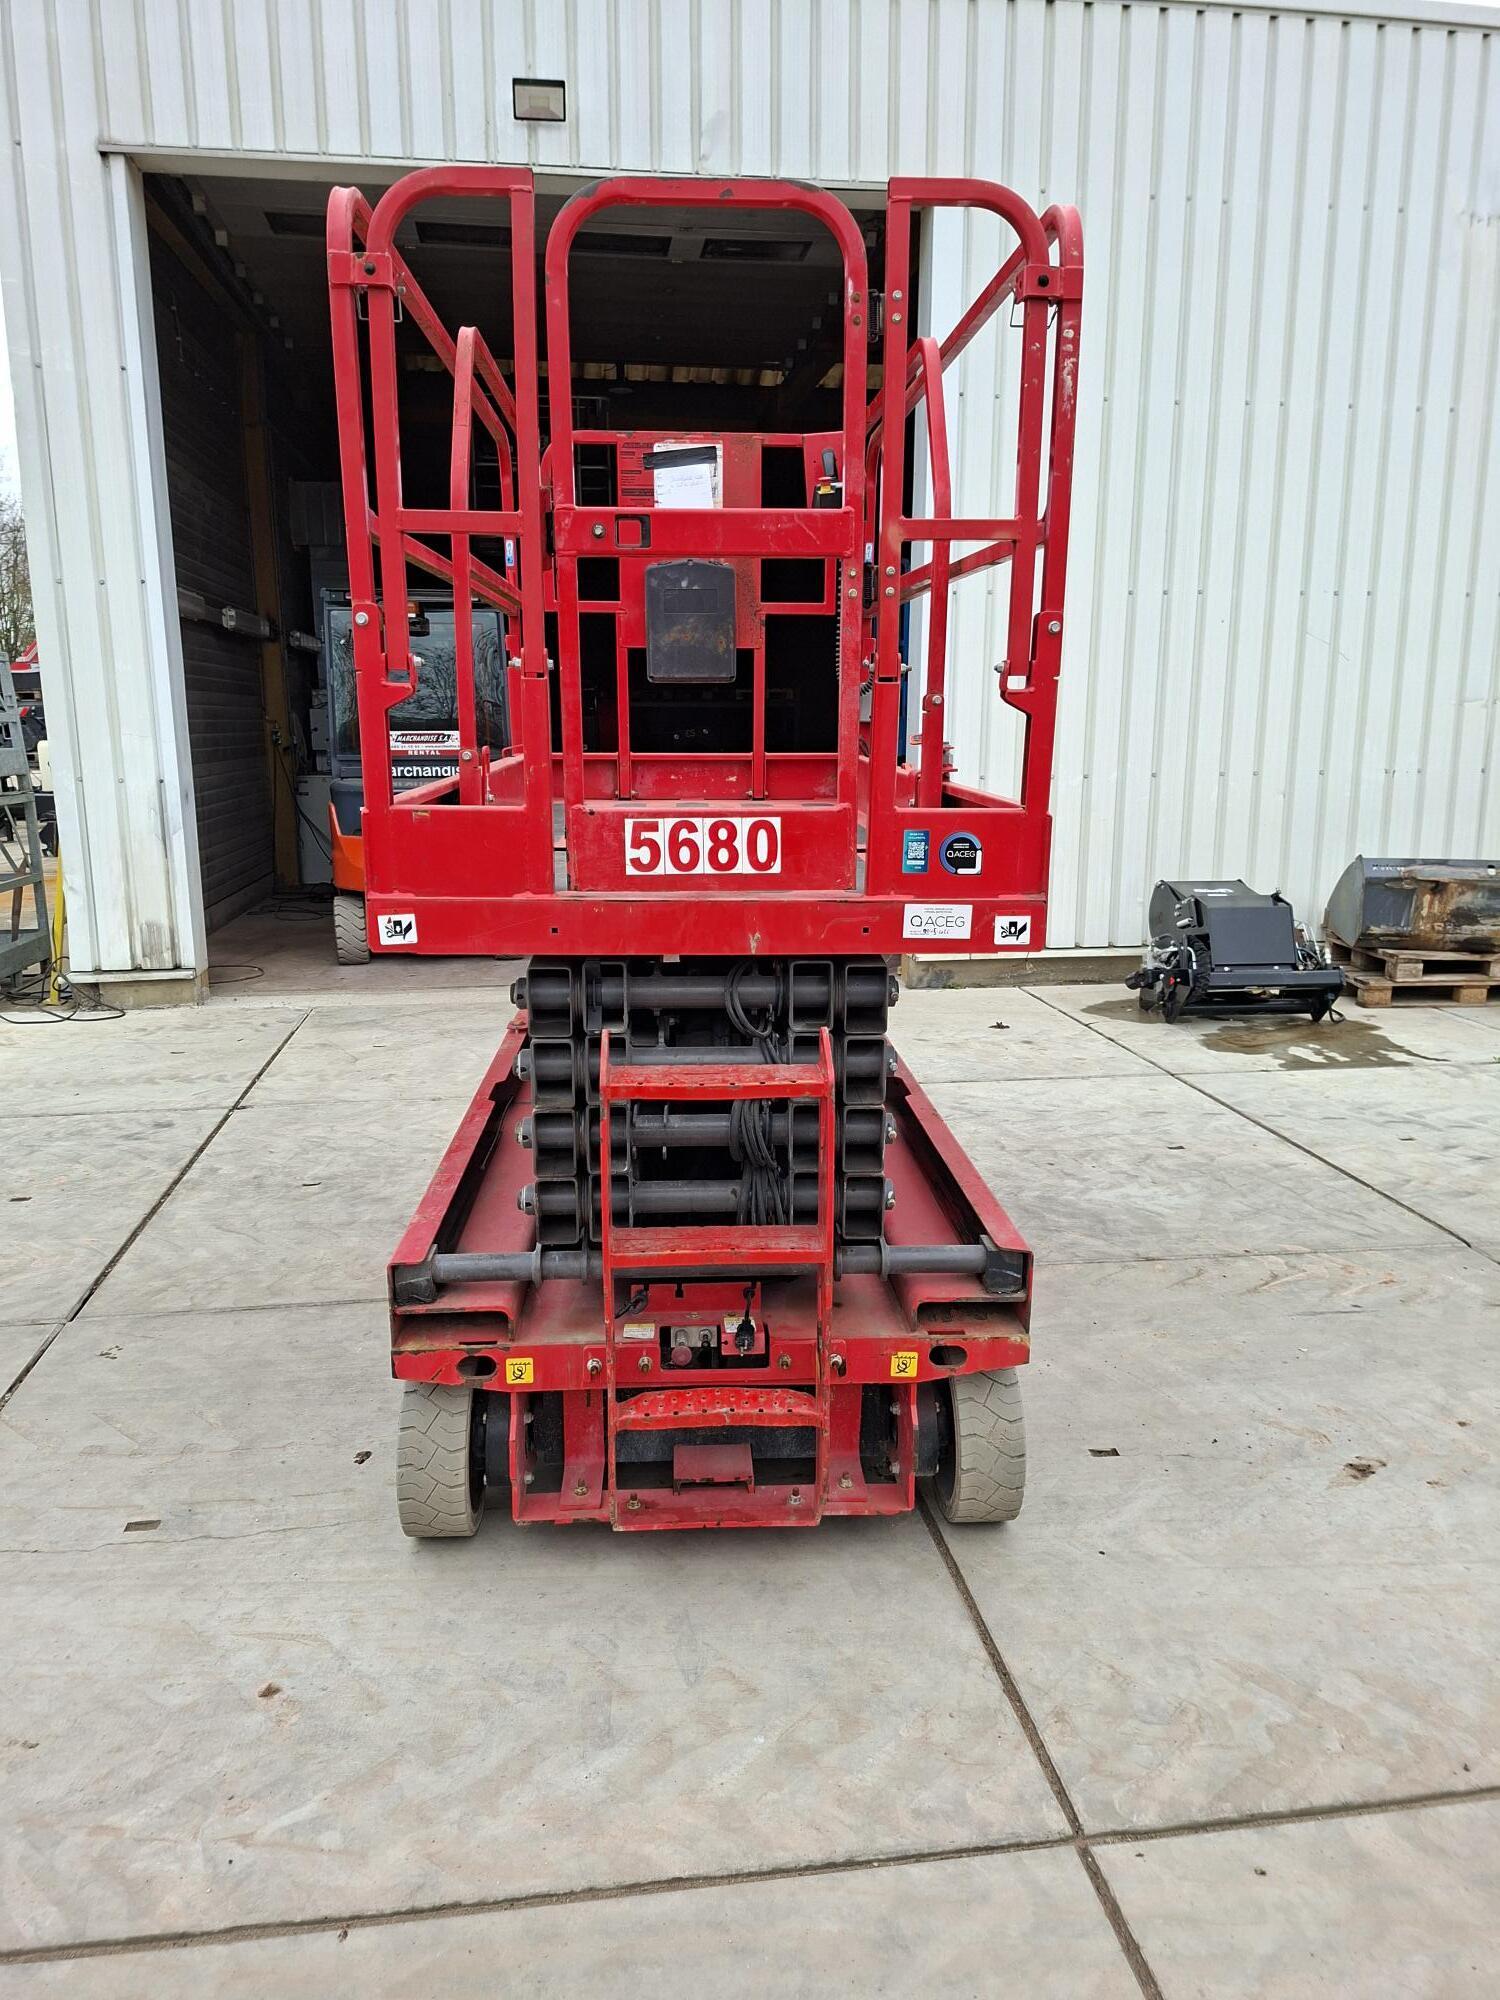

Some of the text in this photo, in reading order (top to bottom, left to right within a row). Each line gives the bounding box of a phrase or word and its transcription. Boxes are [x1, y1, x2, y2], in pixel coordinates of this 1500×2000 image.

[396, 734, 438, 742] MARCHANDISE
[391, 765, 460, 777] archandis
[629, 819, 778, 872] 5680
